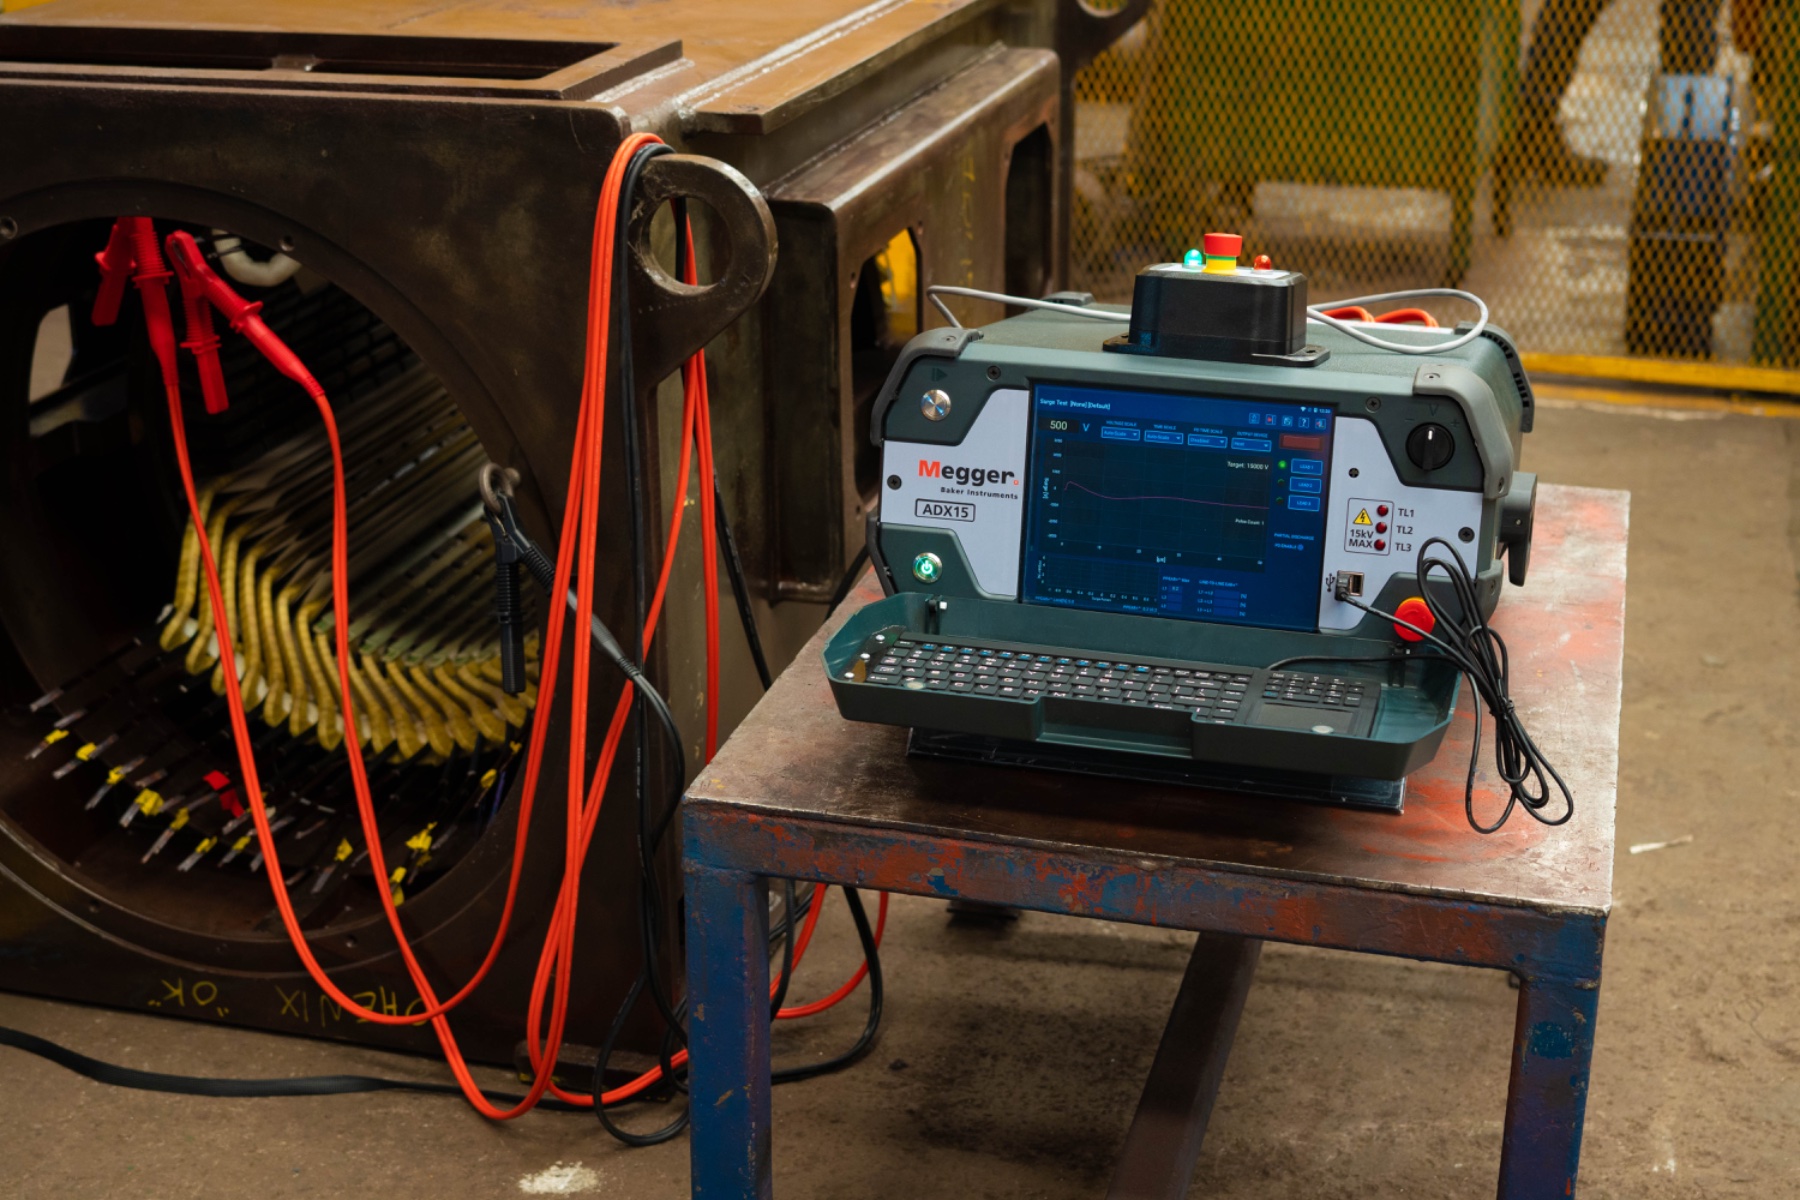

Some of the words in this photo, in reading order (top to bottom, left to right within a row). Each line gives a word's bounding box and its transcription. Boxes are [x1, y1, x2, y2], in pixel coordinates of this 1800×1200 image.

[1050, 420, 1068, 430] 500
[1082, 423, 1090, 432] V
[941, 487, 964, 495] Baker
[967, 489, 1018, 500] Instruments
[923, 504, 969, 518] ADX15
[1398, 508, 1414, 517] TL1
[1350, 529, 1374, 539] 15kV
[1396, 525, 1413, 534] TL2
[1349, 539, 1373, 549] MAX
[1395, 542, 1412, 552] TL3
